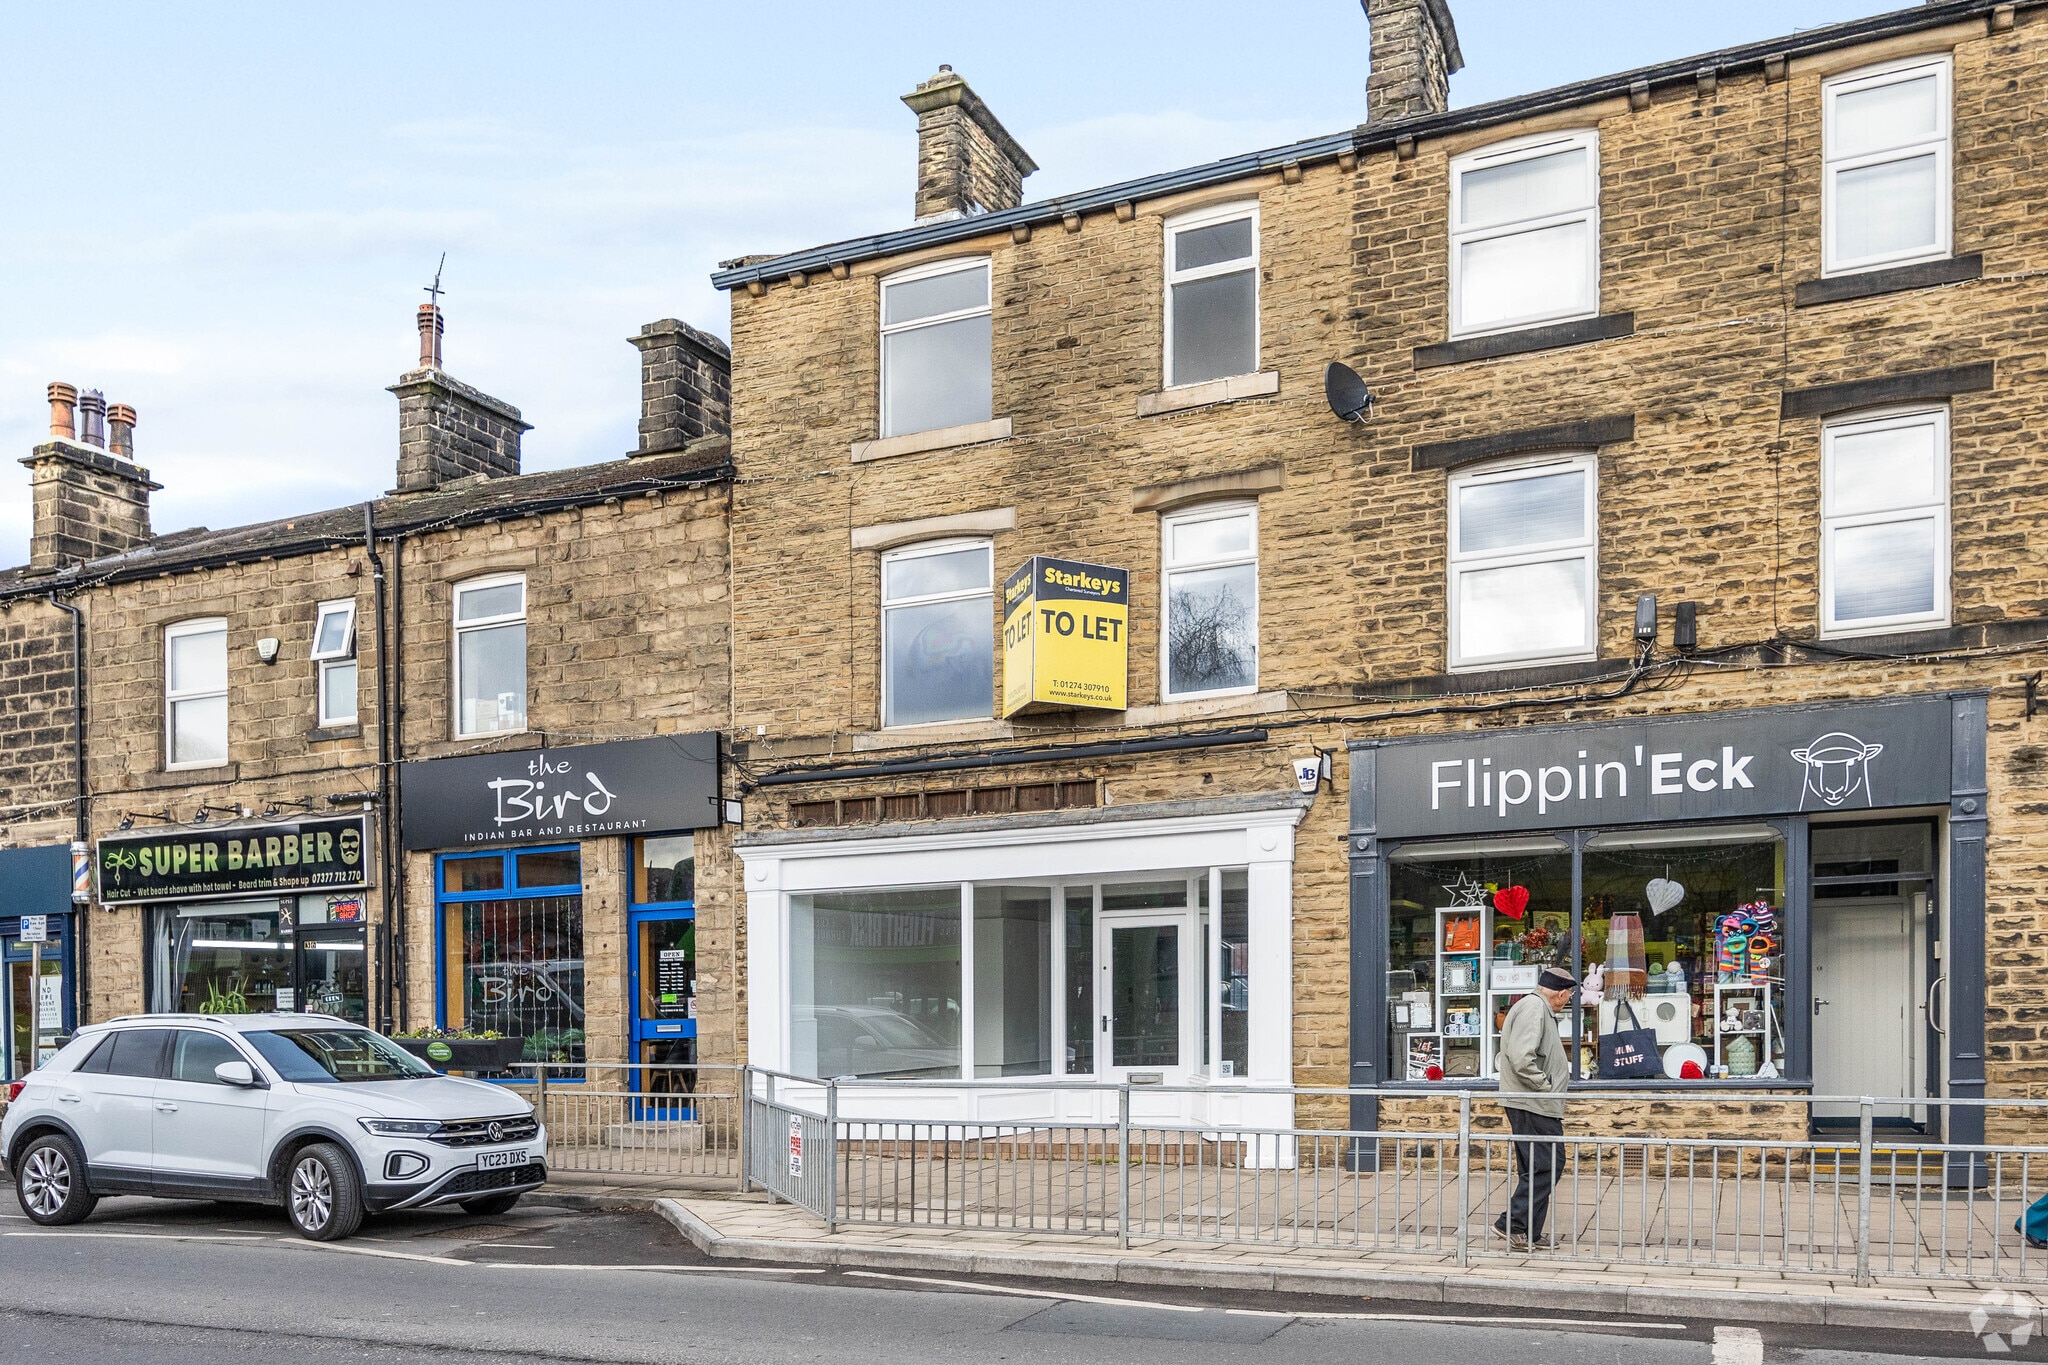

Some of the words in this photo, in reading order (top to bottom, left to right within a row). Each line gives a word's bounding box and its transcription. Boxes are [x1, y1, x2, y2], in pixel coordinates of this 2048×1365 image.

[1006, 572, 1031, 604] Starkeys
[1045, 567, 1120, 596] Starkeys
[1005, 624, 1015, 652] TO
[1017, 611, 1031, 643] LET
[1041, 609, 1074, 636] TO
[1083, 615, 1122, 642] LET
[1049, 690, 1112, 701] www.starkeys.co.uk
[1060, 681, 1082, 689] 01274
[1084, 683, 1109, 692] 307910
[528, 754, 572, 776] the
[488, 772, 616, 827] Bird
[464, 831, 505, 841] INDIAN
[511, 828, 532, 838] BAR
[539, 826, 562, 836] AND
[569, 819, 647, 833] RESTAURANT
[139, 842, 218, 876] SUPER
[228, 831, 333, 870] BARBER
[107, 889, 119, 898] Hair
[120, 888, 131, 897] Cut
[137, 888, 149, 896] Wet
[151, 885, 168, 895] beard
[169, 884, 188, 894] shave
[188, 883, 201, 892] with
[203, 882, 214, 892] hot
[214, 881, 231, 891] towel
[238, 879, 257, 889] Beard
[258, 878, 272, 888] trim
[272, 878, 278, 886] &
[280, 877, 300, 888] Shape
[301, 877, 309, 886] up
[312, 872, 333, 883] 07377
[335, 872, 346, 882] 712
[348, 870, 361, 880] 770
[335, 904, 358, 912] BARBER
[339, 911, 356, 919] SHOP
[23, 920, 28, 929] P
[503, 963, 529, 976] the
[479, 975, 556, 1002] Bird
[1614, 1054, 1644, 1066] STUFF
[482, 1153, 507, 1167] YC23
[510, 1151, 526, 1164] DXS
